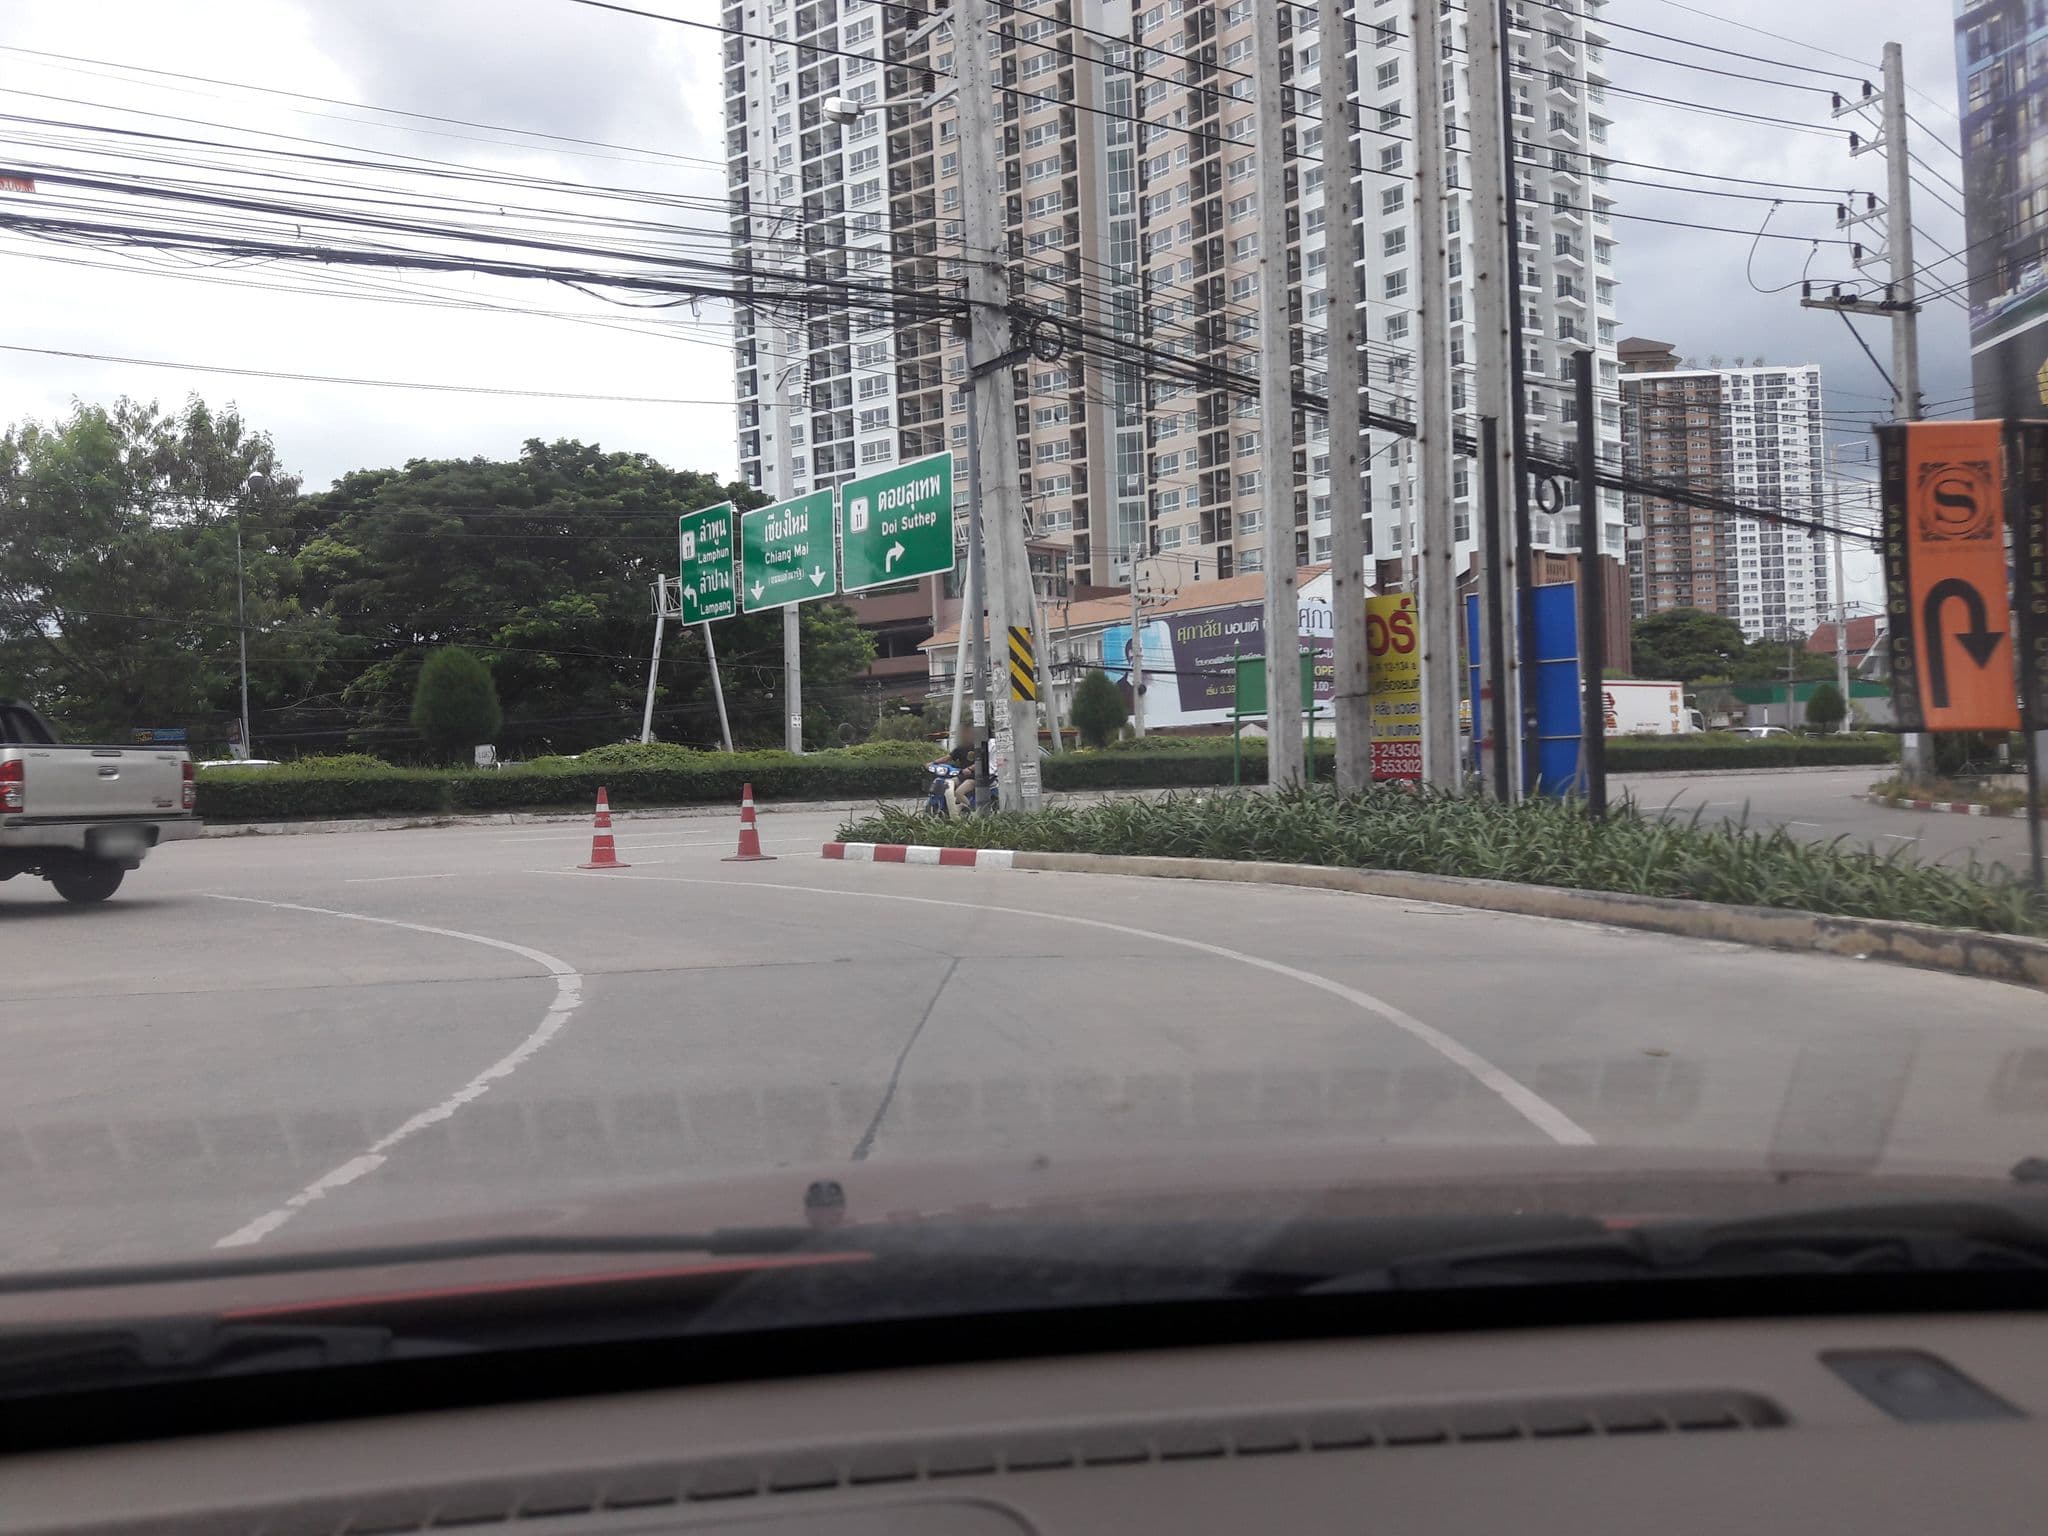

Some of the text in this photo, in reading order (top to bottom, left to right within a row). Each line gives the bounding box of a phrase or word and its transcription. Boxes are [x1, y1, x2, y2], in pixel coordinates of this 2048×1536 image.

[878, 474, 940, 511] ดอยสุเทพ
[1934, 479, 1976, 523] S
[700, 518, 727, 546] ลำพูน
[764, 506, 808, 543] เชียงใหม่
[881, 511, 937, 536] Doi Suthep
[698, 547, 730, 564] Lamphun
[764, 542, 809, 564] Chiang Mai
[1887, 504, 1907, 614] SPRING
[700, 568, 729, 595] ลำปาง
[700, 600, 731, 615] Lampang
[1370, 744, 1422, 758] 3-24350
